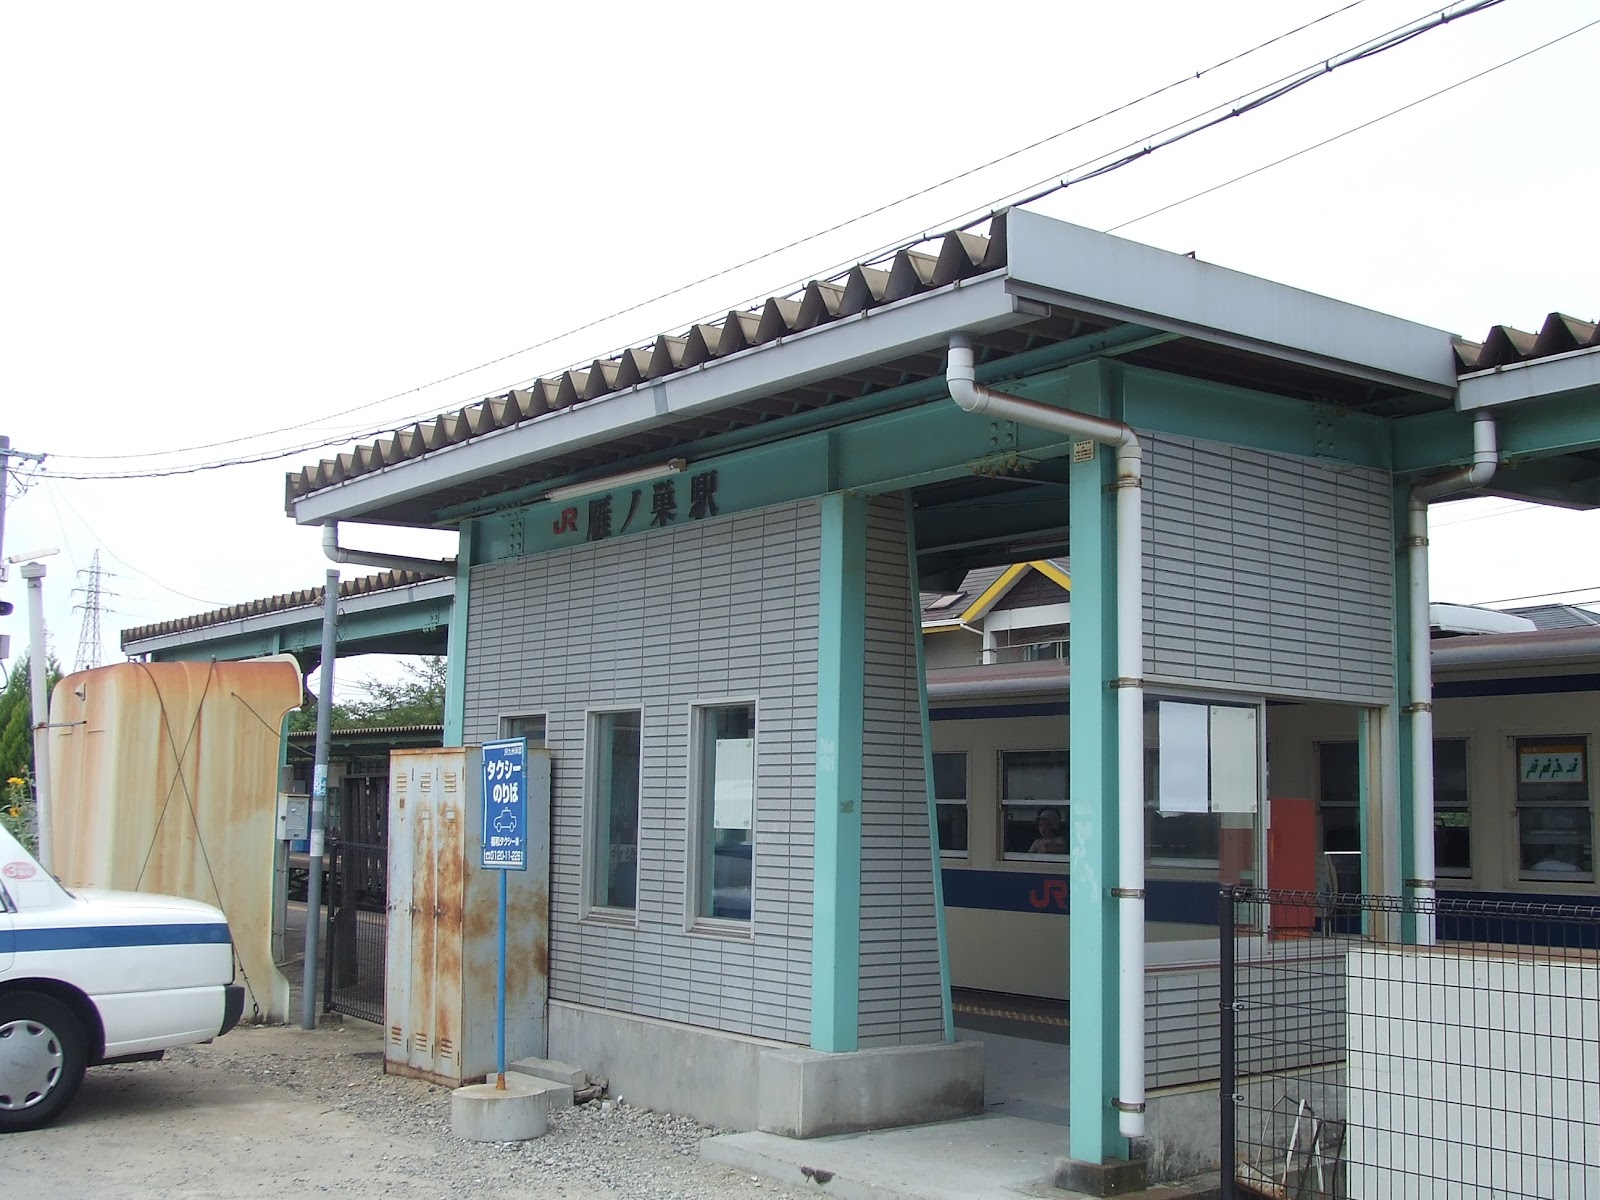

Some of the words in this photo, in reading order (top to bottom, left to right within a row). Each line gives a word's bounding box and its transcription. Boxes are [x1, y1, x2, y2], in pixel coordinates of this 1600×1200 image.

[553, 507, 578, 535] JR
[487, 760, 521, 780] タクシー
[493, 782, 518, 803] のりば
[1030, 880, 1068, 909] JR
